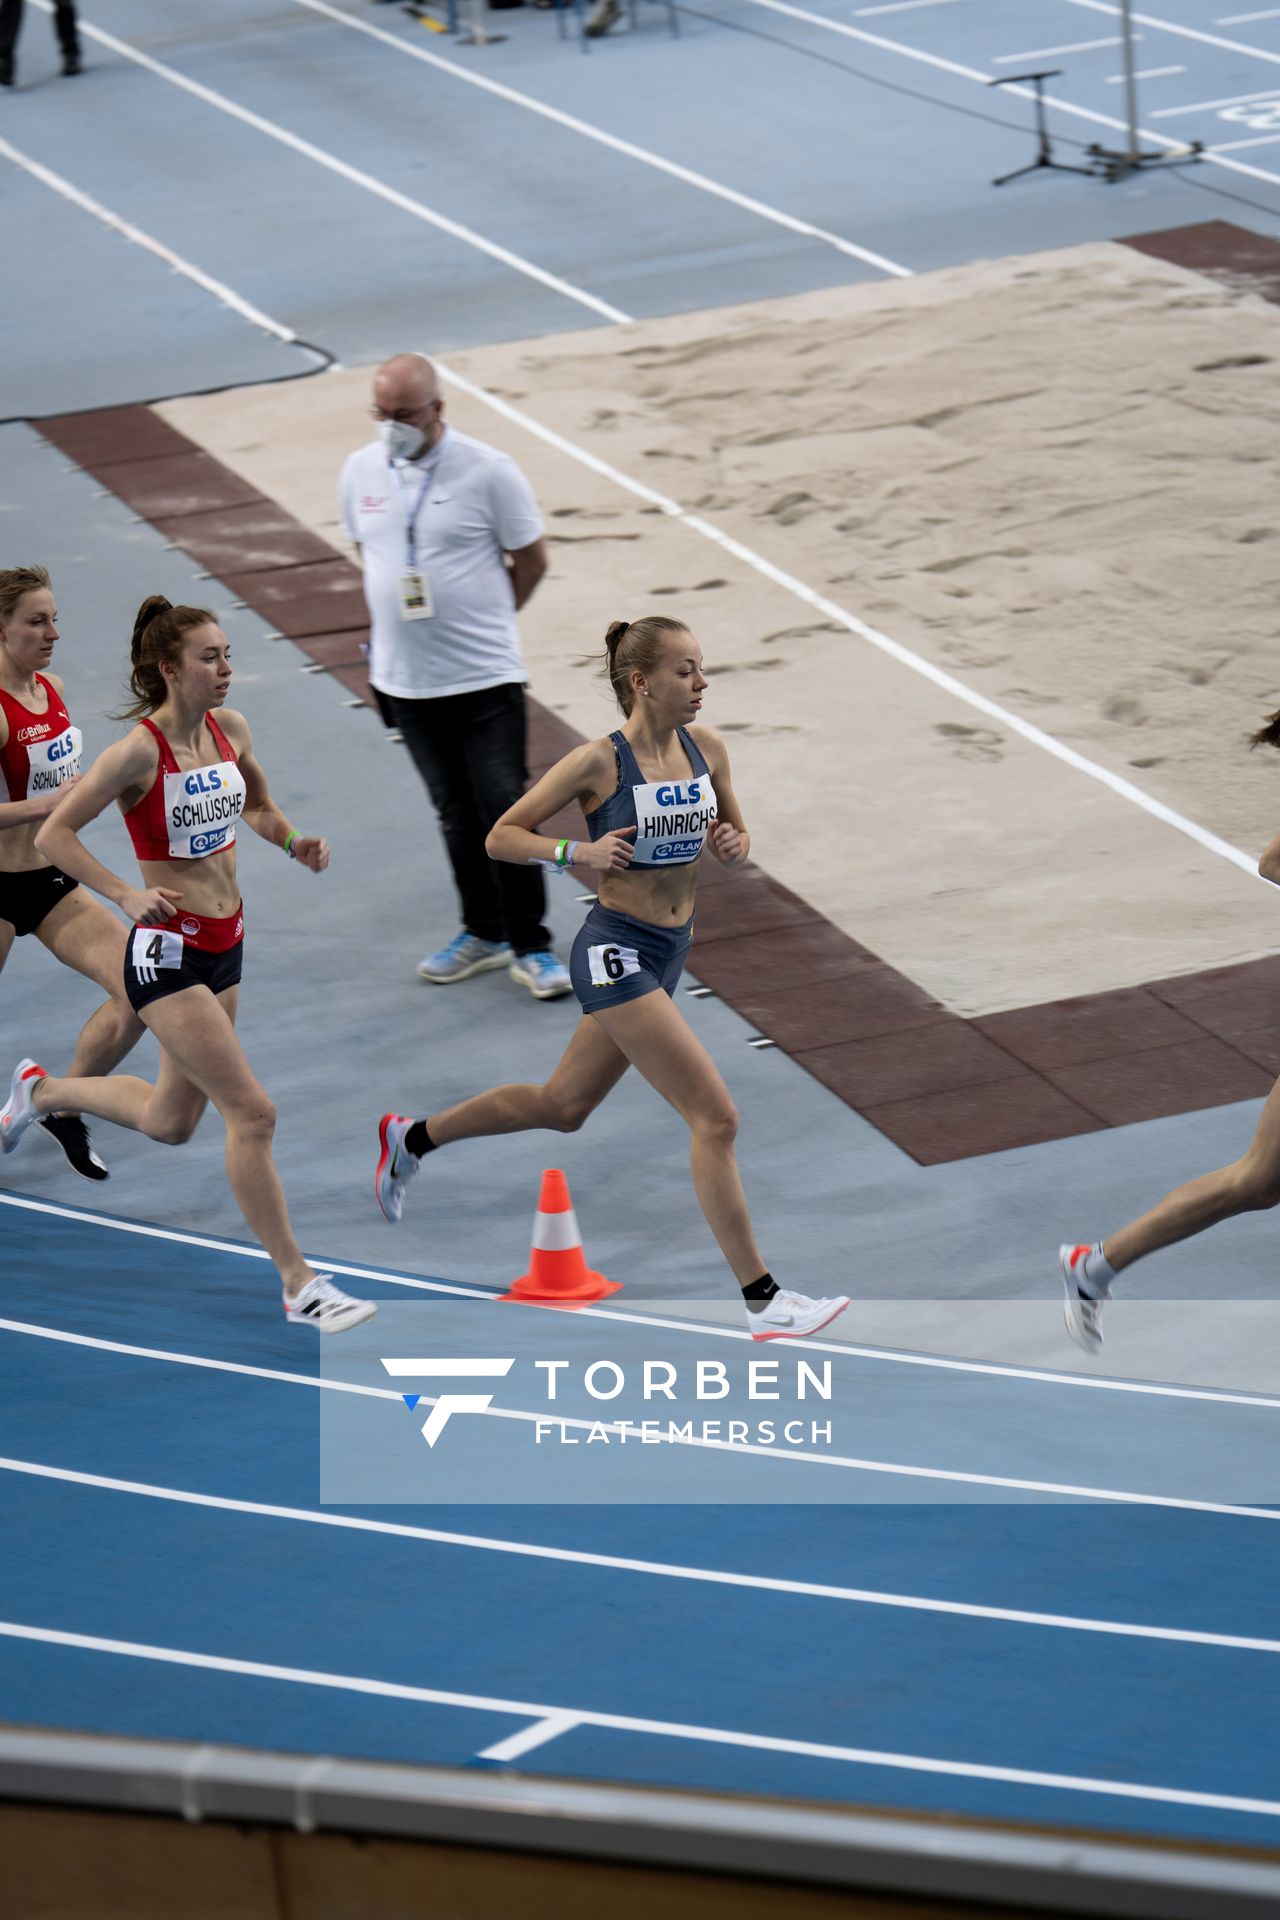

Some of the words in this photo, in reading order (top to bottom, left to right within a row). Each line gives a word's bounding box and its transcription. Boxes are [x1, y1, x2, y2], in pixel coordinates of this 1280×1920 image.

[172, 792, 242, 828] SCHLÜSCHE
[145, 934, 164, 966] 4
[602, 947, 624, 979] 6
